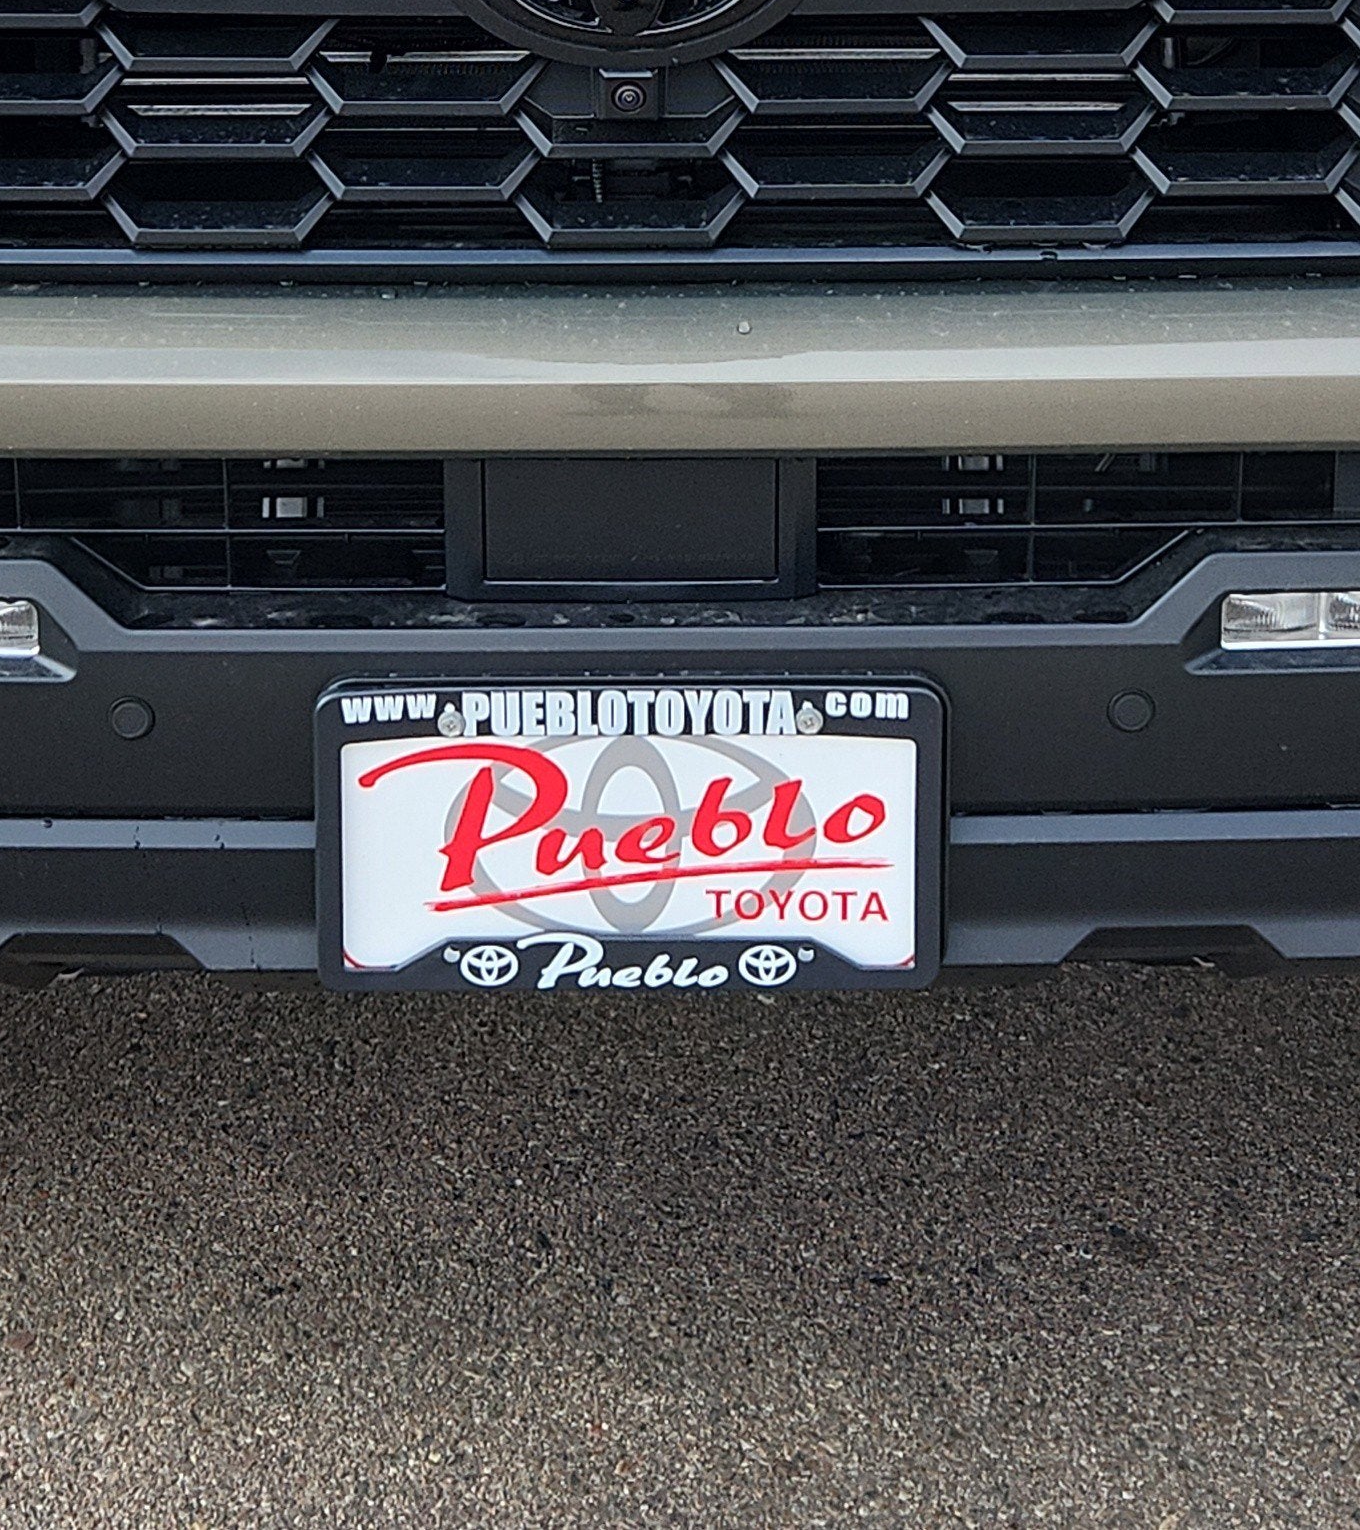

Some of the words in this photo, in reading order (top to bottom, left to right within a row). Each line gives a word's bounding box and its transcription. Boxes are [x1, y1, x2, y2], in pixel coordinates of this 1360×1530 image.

[358, 743, 887, 892] Pueblo
[705, 889, 890, 922] TOYOTA
[516, 933, 729, 989] Pueblo
